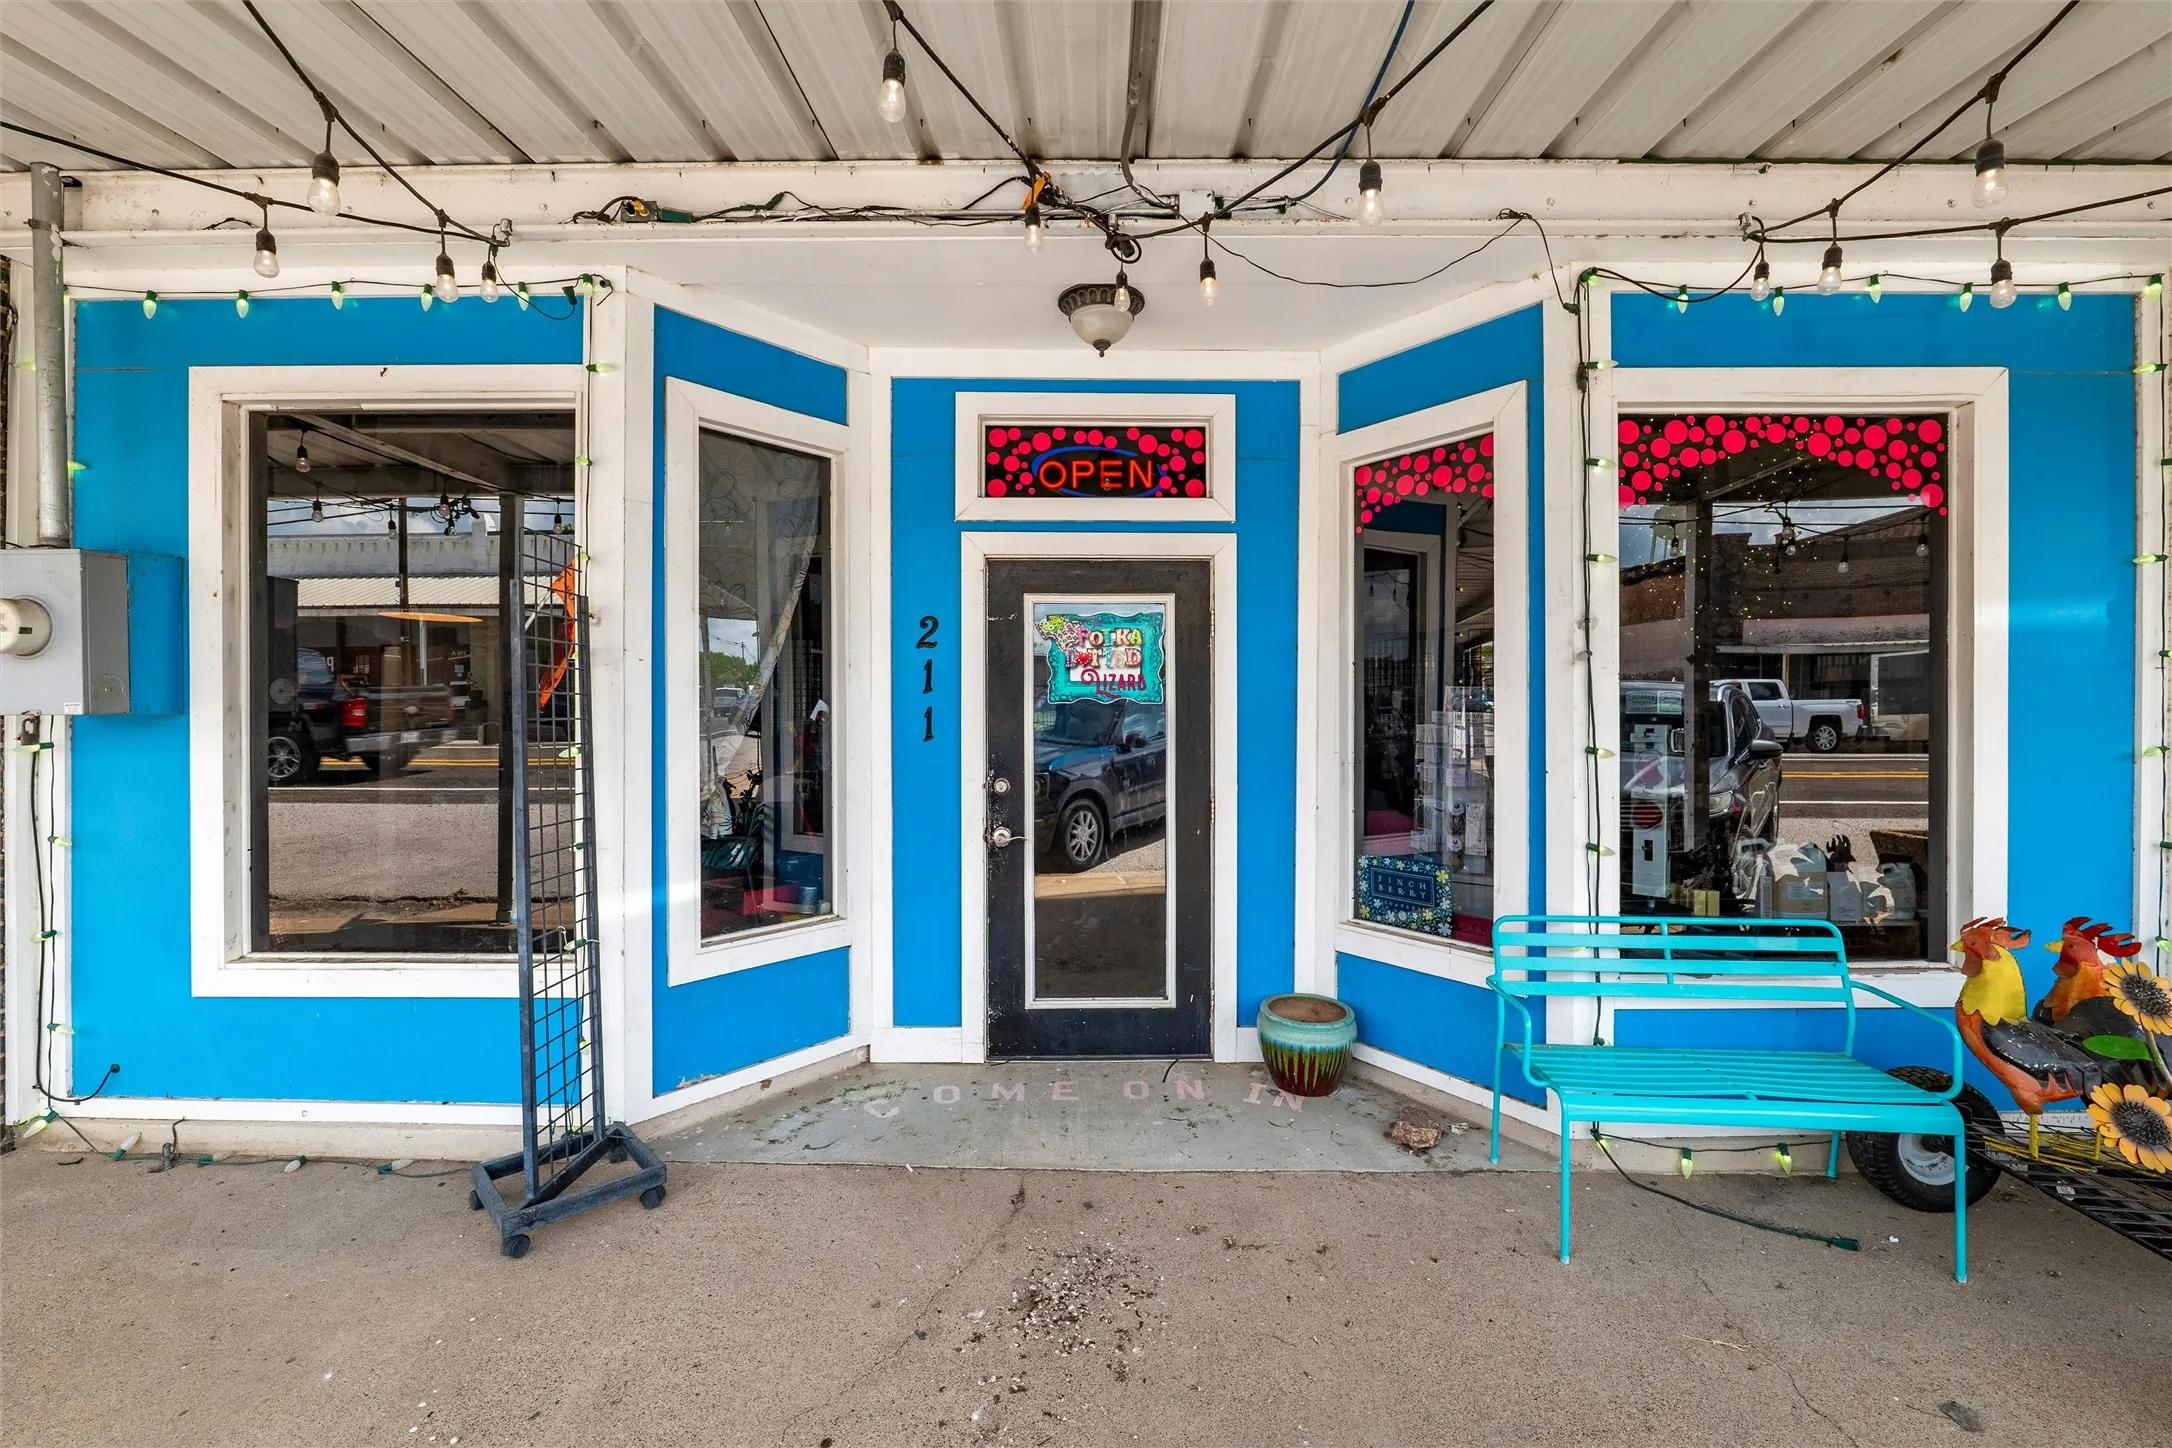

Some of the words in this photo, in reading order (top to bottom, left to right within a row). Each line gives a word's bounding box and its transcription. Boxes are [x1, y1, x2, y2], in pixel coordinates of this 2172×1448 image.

[1039, 460, 1152, 489] OPEN
[1077, 627, 1142, 647] POLKA
[916, 615, 939, 742] 211
[1081, 668, 1147, 699] LIZARD
[1378, 875, 1427, 890] FINCH
[1378, 884, 1426, 899] BERRY
[863, 1081, 1079, 1118] COME
[1123, 1079, 1205, 1101] ON
[1243, 1083, 1305, 1112] IN
